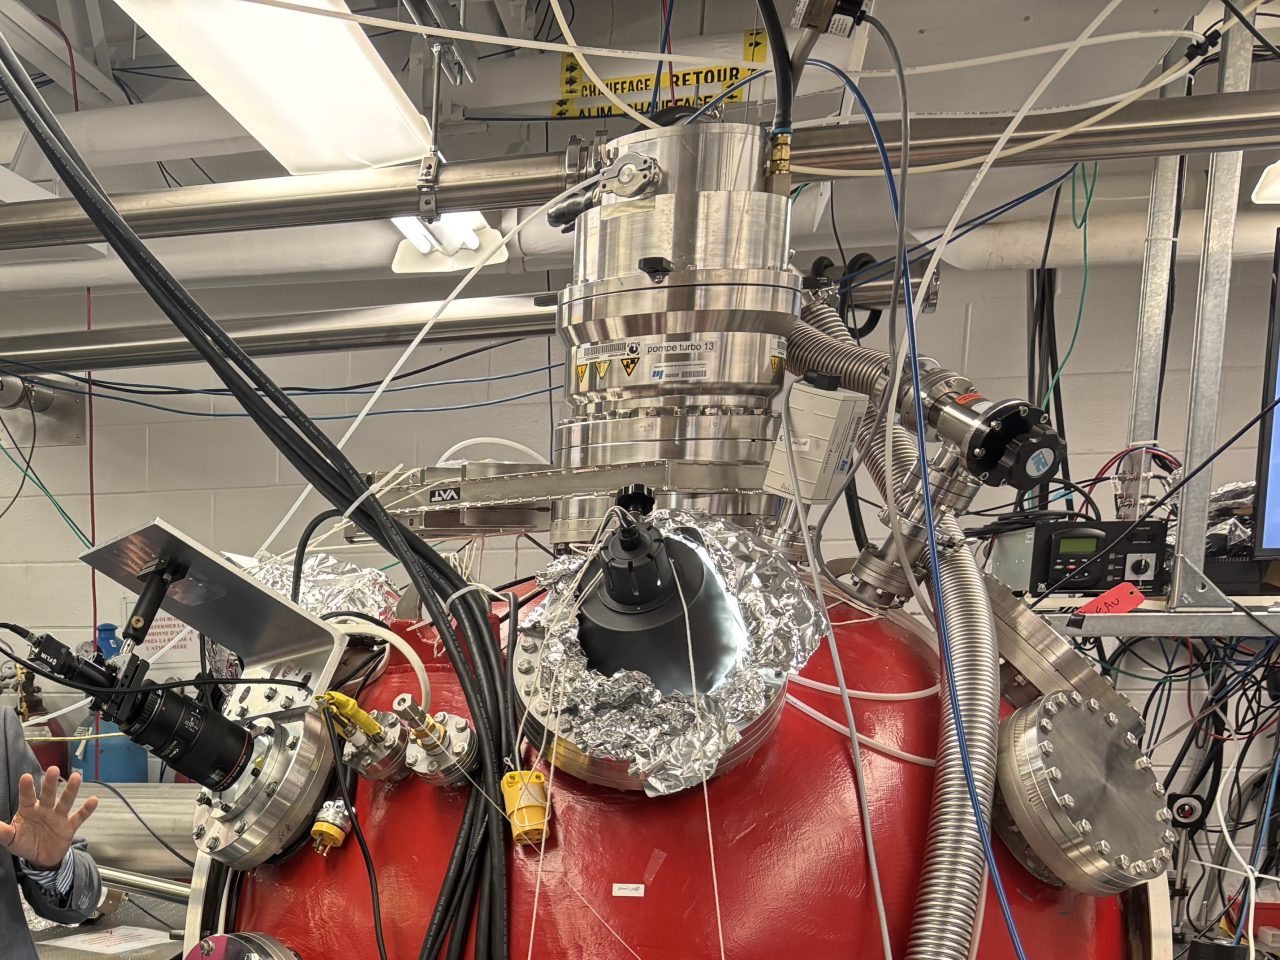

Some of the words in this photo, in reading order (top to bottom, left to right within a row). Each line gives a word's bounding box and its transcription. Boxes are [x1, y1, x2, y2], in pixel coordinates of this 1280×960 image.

[672, 67, 739, 87] RETOUR
[647, 344, 677, 355] pompe
[680, 342, 702, 352] turbo
[704, 342, 714, 350] 13
[431, 489, 458, 501] VAT
